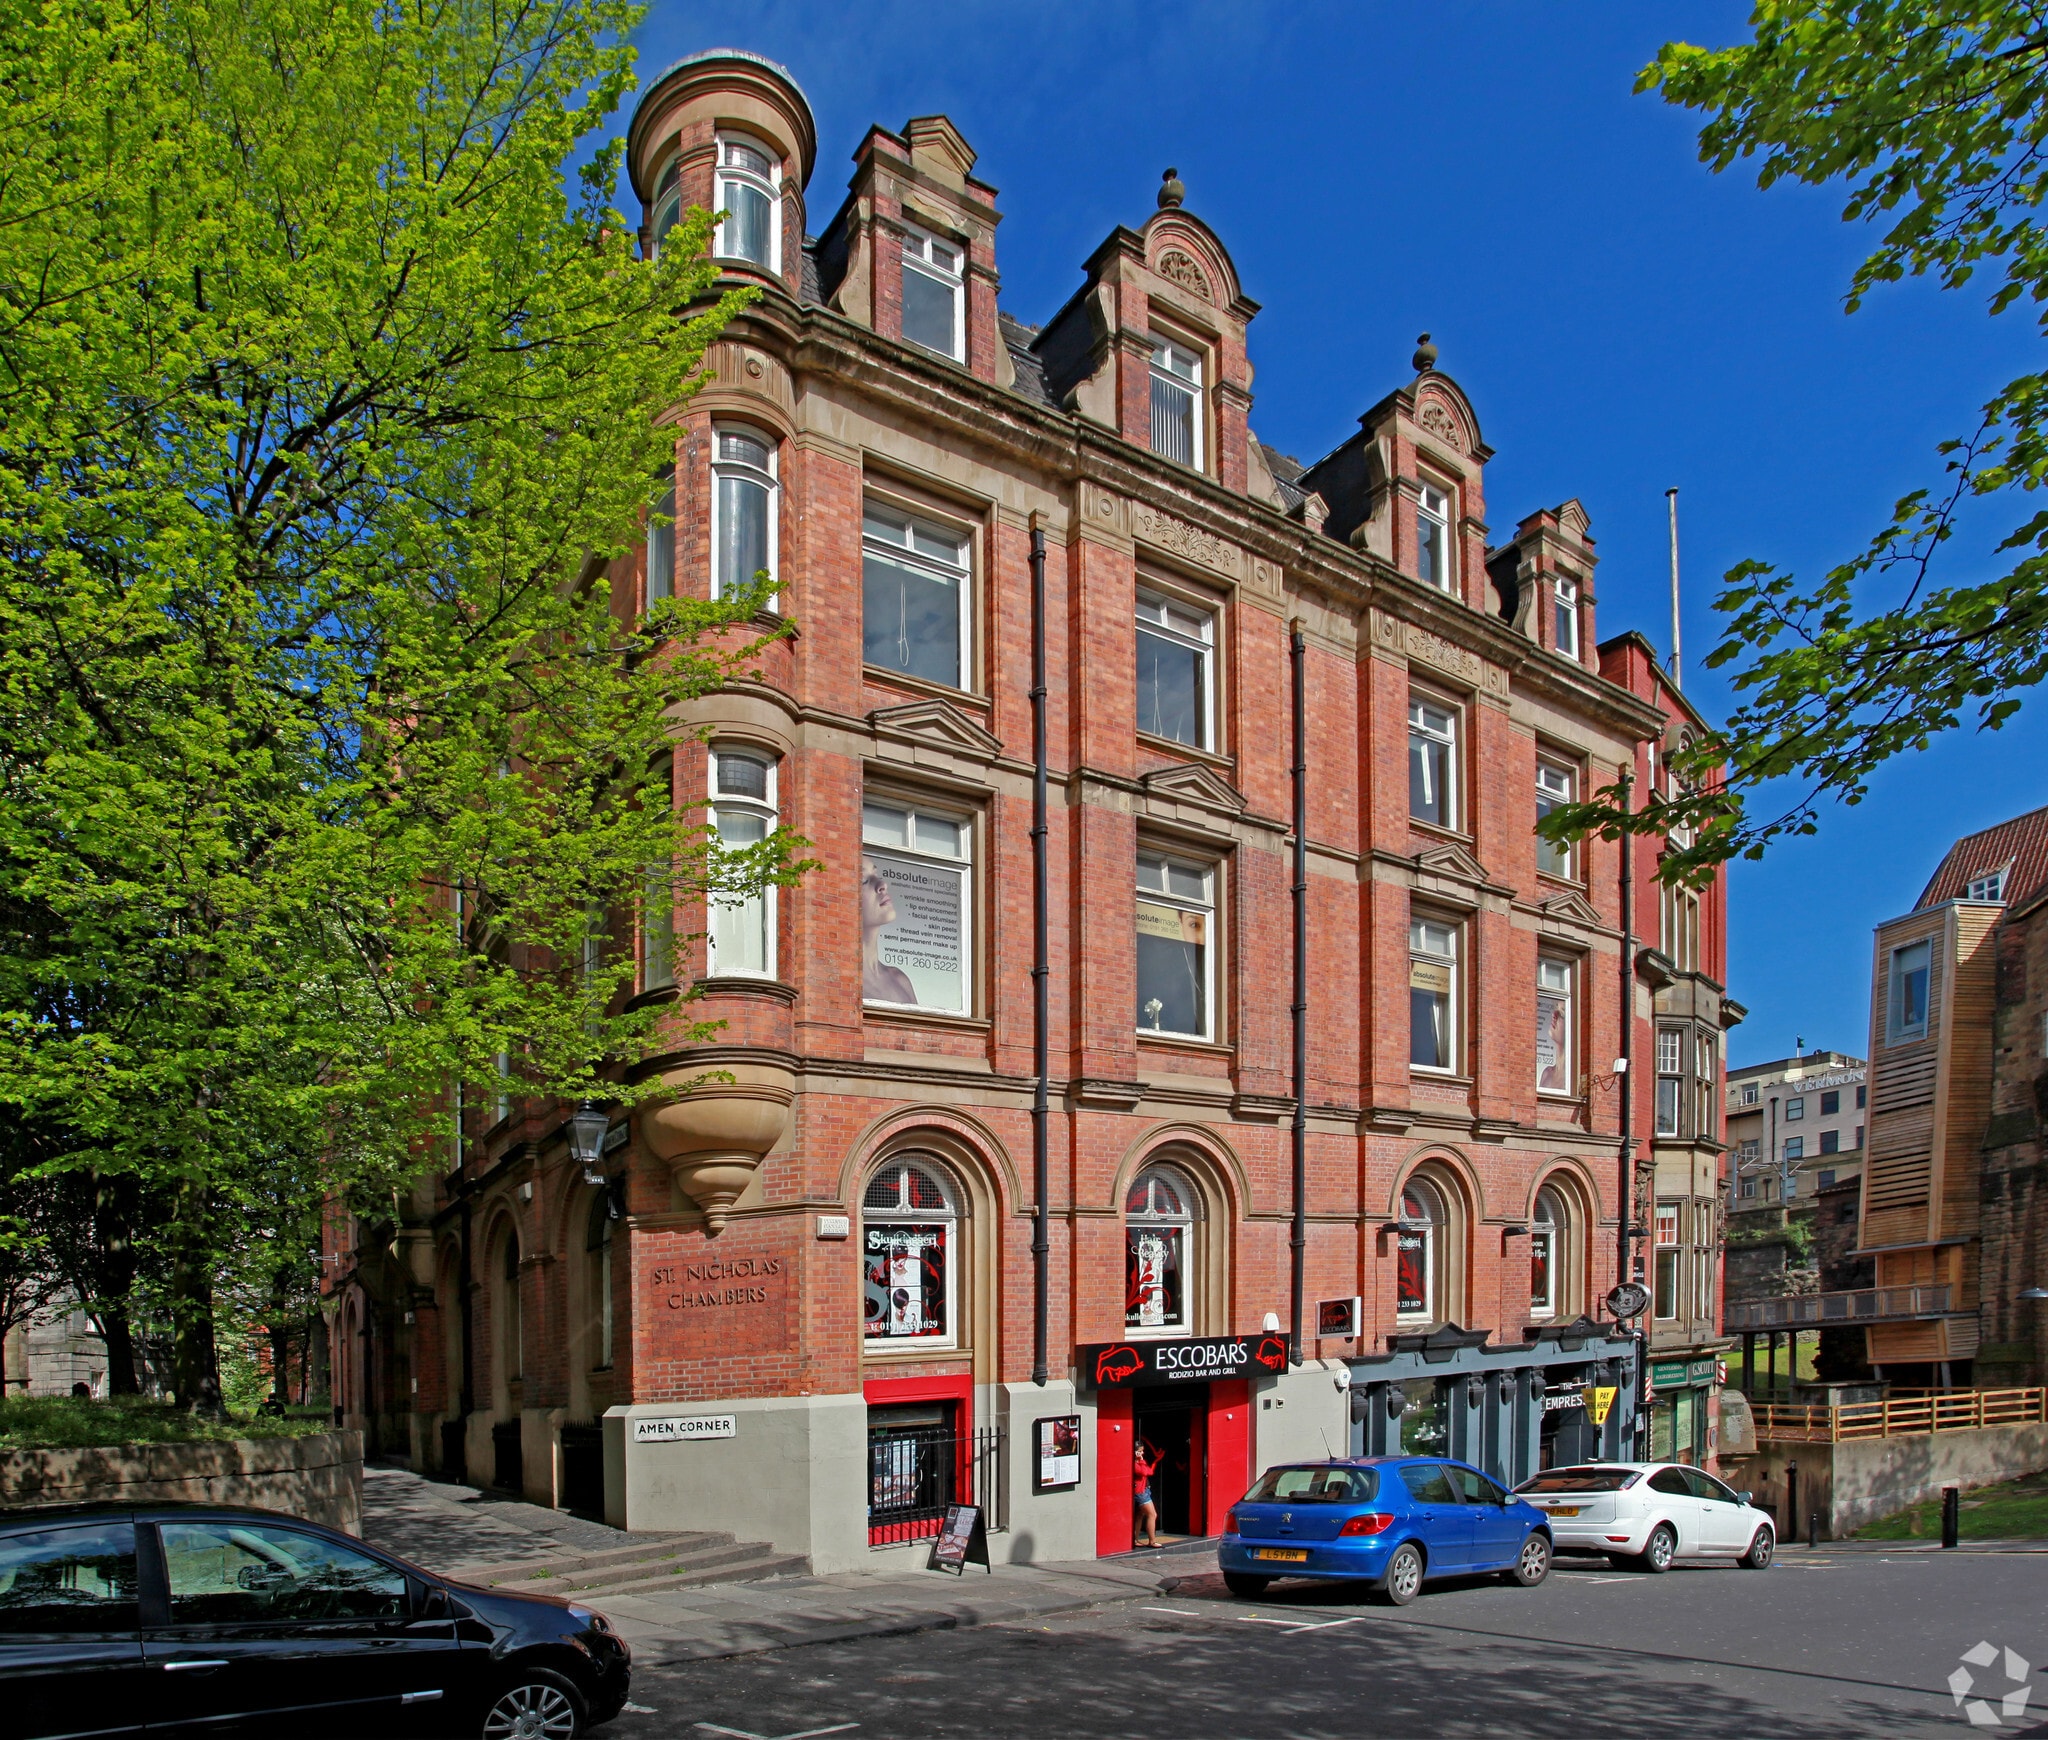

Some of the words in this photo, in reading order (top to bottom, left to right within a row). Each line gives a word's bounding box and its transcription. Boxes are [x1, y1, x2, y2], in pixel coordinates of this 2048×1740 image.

[904, 894, 925, 902] wrinkle
[926, 897, 957, 909] smoothing
[909, 902, 918, 910] lip
[918, 904, 957, 916] enhancement
[912, 912, 928, 920] facial
[929, 915, 957, 925] volumiser
[1136, 914, 1180, 928] soluteimage
[900, 927, 919, 936] thread
[921, 930, 933, 938] vein
[934, 932, 957, 941] removal
[928, 922, 941, 931] skin
[941, 924, 957, 933] peels
[884, 933, 899, 941] semi
[900, 936, 932, 945] permanent
[933, 940, 948, 948] make
[884, 946, 957, 961] www.absolute-image.co.uk
[884, 953, 909, 966] 0191
[912, 957, 931, 969] 260
[934, 960, 958, 973] 5222
[1792, 1070, 1867, 1092] VERMON
[654, 1267, 676, 1285] ST.
[687, 1257, 780, 1282] NICHOLAS
[668, 1285, 767, 1310] CHAMBERS
[919, 1319, 938, 1330] 1029
[1168, 1370, 1195, 1379] RODIZIO
[1195, 1370, 1208, 1378] BAR
[1208, 1369, 1222, 1377] AND
[1222, 1367, 1237, 1375] GRILL
[1563, 1382, 1573, 1390] THE
[1596, 1401, 1610, 1409] HERE
[638, 1423, 674, 1434] AMEN
[679, 1420, 731, 1432] CORNER
